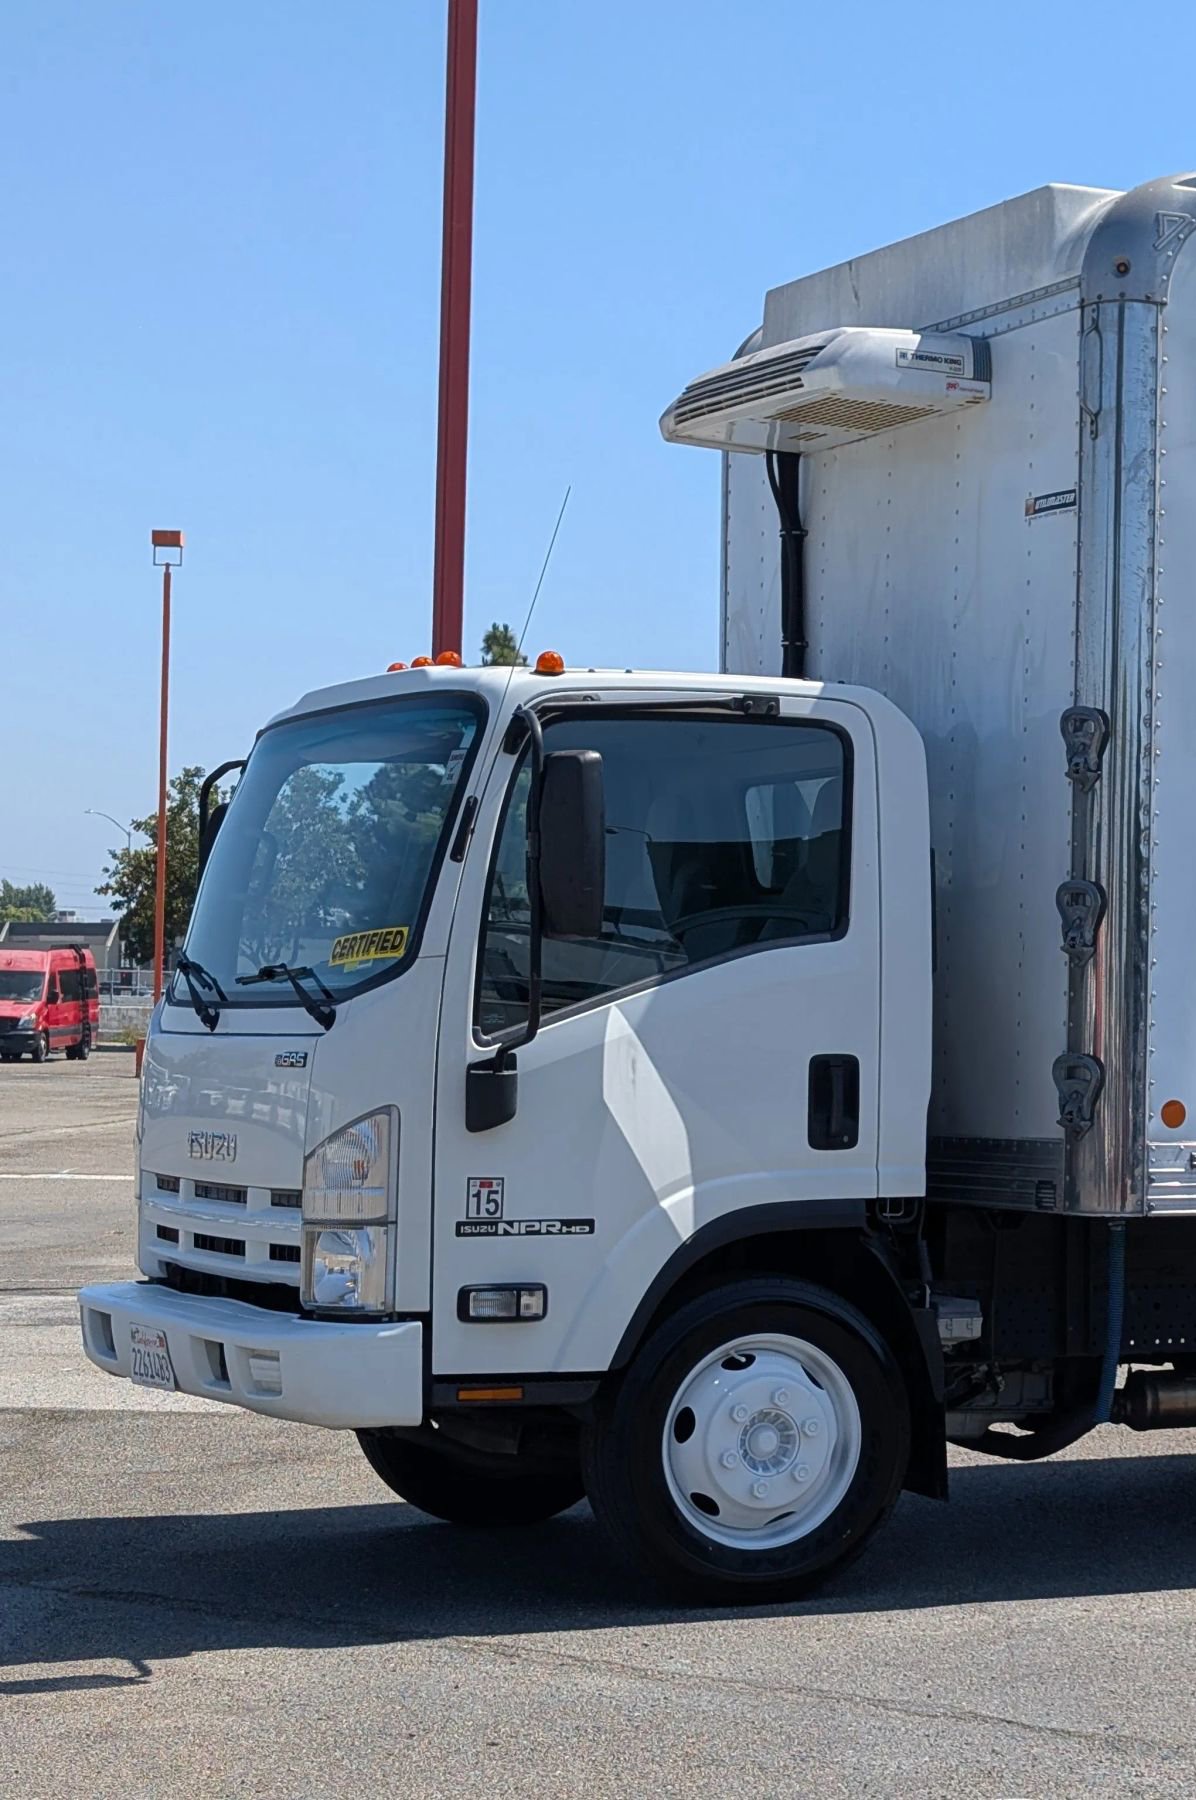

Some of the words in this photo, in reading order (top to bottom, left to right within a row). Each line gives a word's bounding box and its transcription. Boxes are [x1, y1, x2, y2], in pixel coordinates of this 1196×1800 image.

[911, 353, 943, 364] THERMO
[944, 357, 962, 366] KING
[331, 929, 406, 961] CERTIFIED
[282, 1052, 305, 1067] GAS
[188, 1130, 237, 1163] ISUZU
[471, 1189, 500, 1216] 15
[460, 1225, 496, 1234] ISUZU
